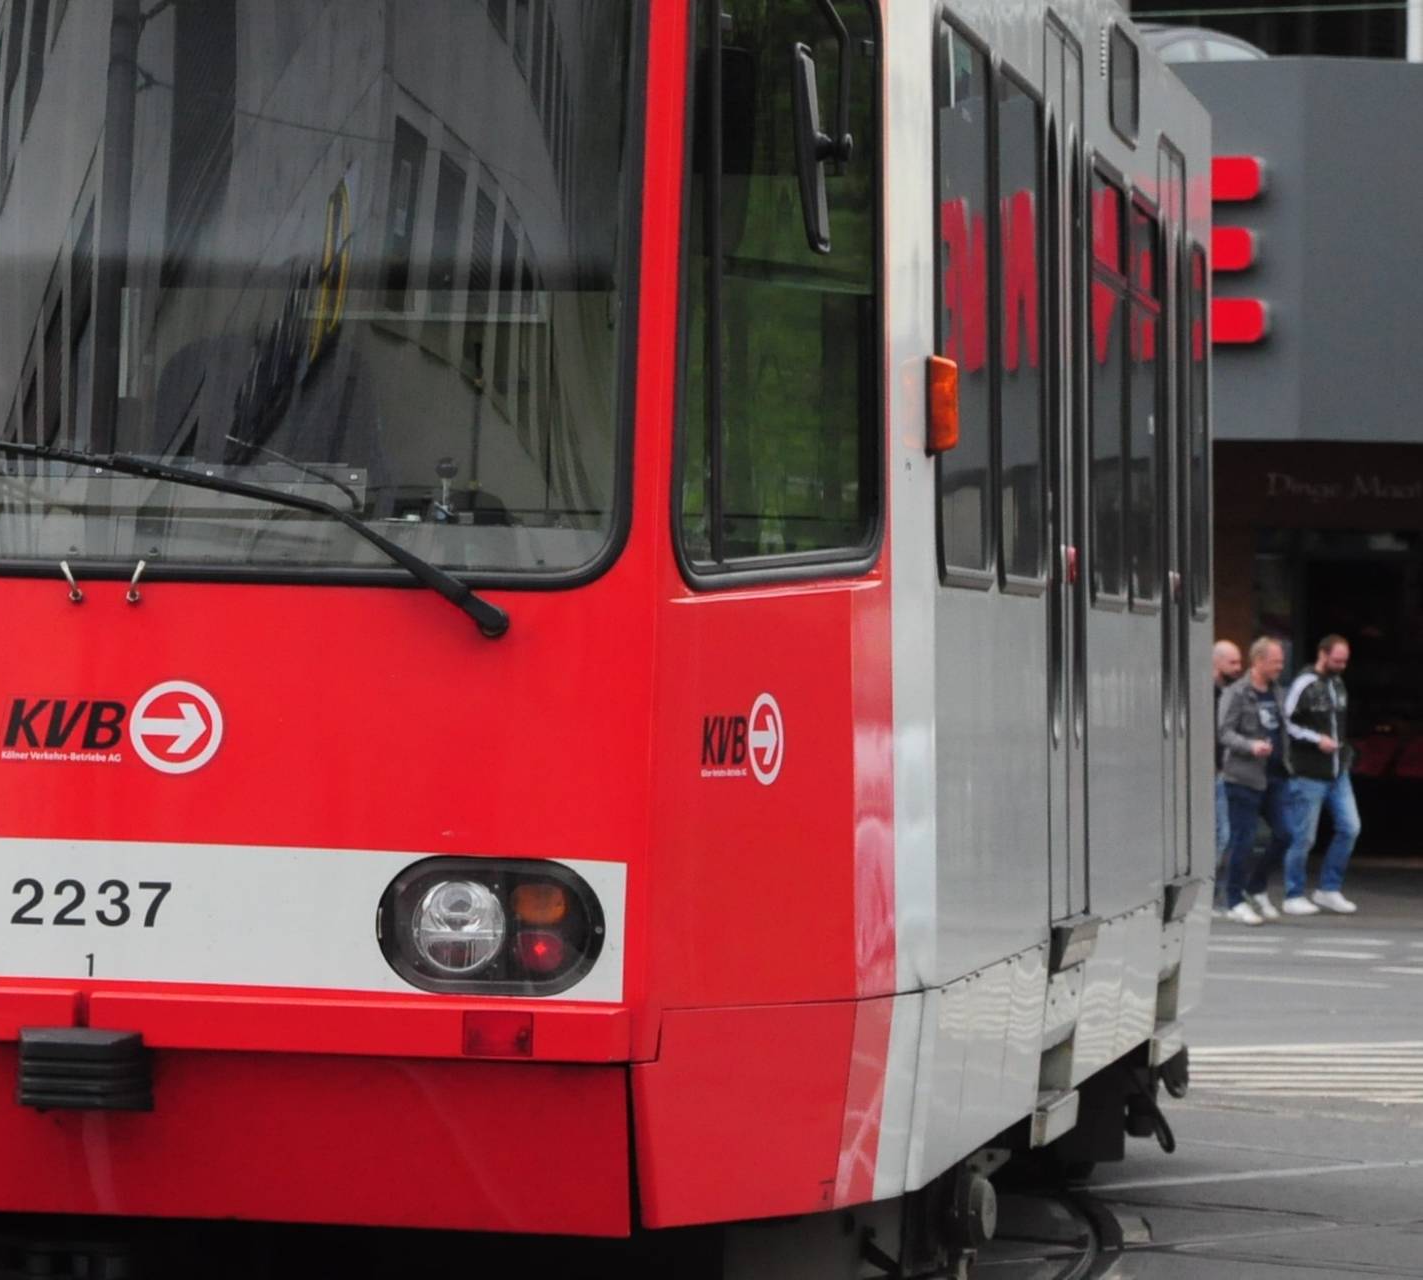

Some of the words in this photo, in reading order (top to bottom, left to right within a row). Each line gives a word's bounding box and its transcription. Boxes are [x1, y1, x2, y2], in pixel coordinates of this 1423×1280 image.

[3, 699, 126, 749] KVB
[701, 715, 748, 765] KVB
[1, 750, 29, 760] Kölner
[108, 753, 121, 763] AG
[11, 878, 172, 928] 2237
[85, 953, 94, 977] 1
